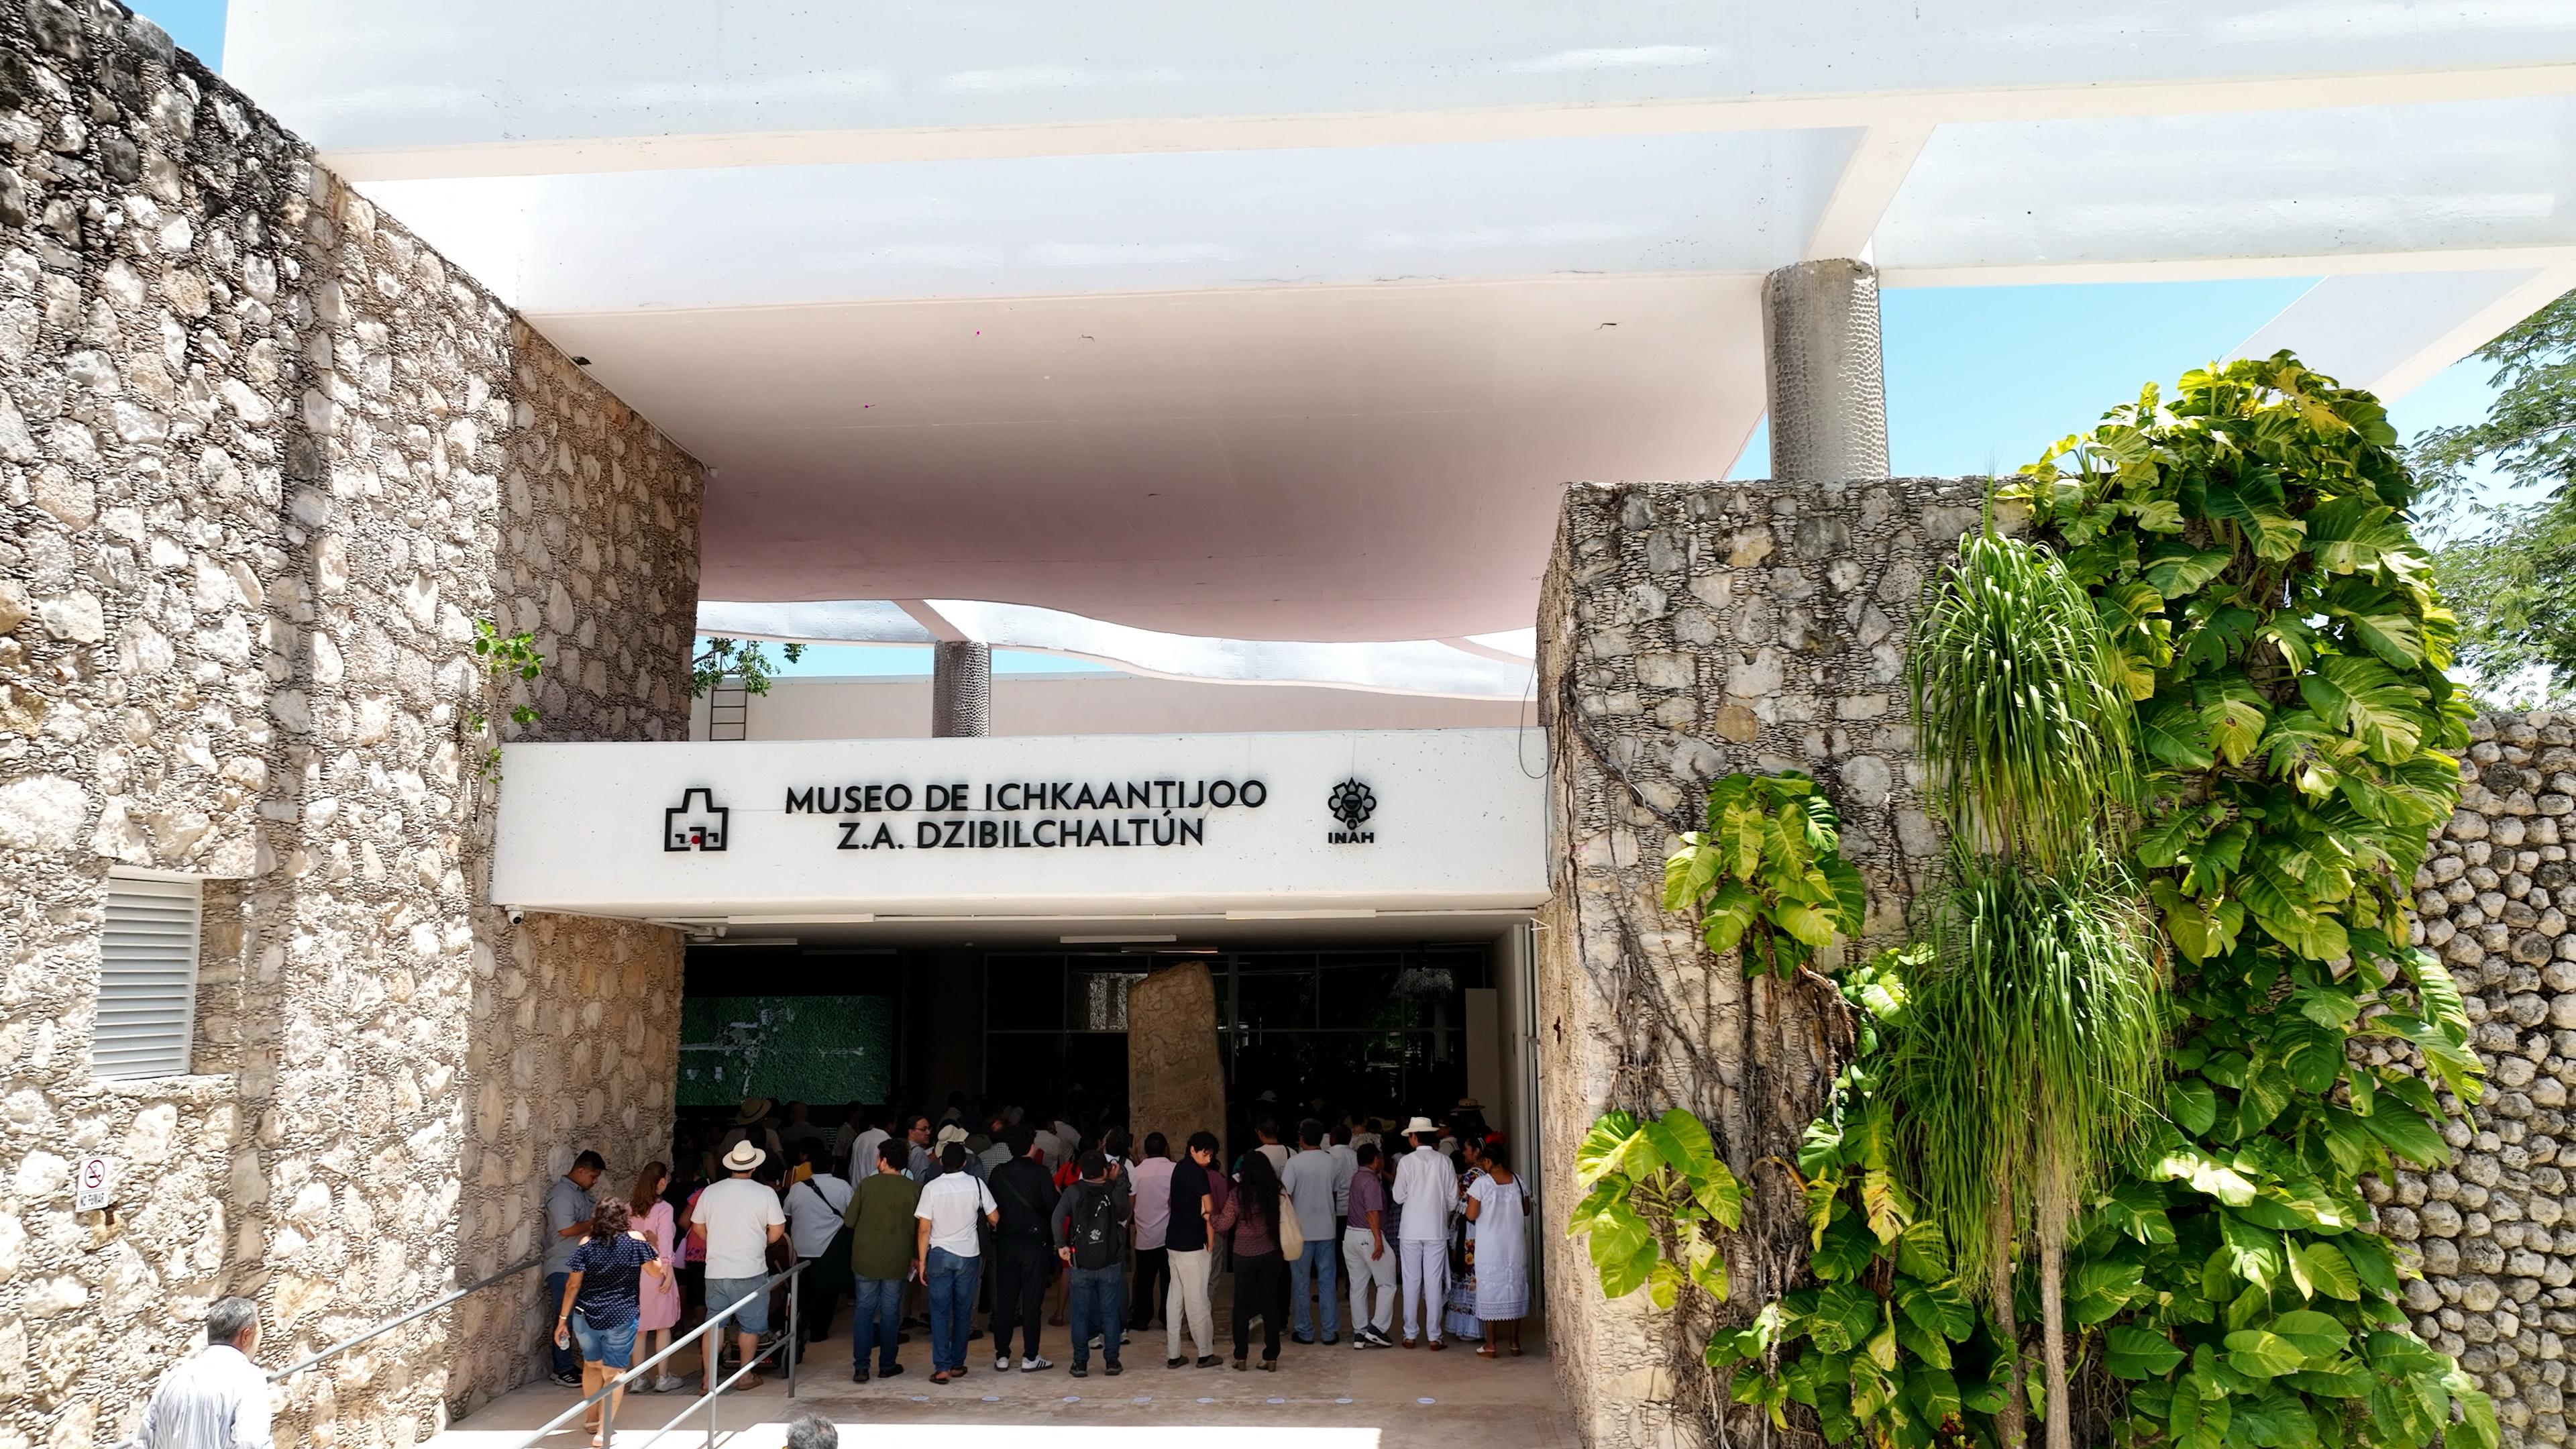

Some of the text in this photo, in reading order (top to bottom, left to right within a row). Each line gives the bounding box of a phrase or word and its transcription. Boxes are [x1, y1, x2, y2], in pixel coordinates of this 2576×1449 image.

[786, 780, 1267, 814] MUSEO DE ICHKAANTIJOO
[837, 808, 1203, 851] Z.A. DZIBILCHALTÚN
[1328, 832, 1375, 844] INAH
